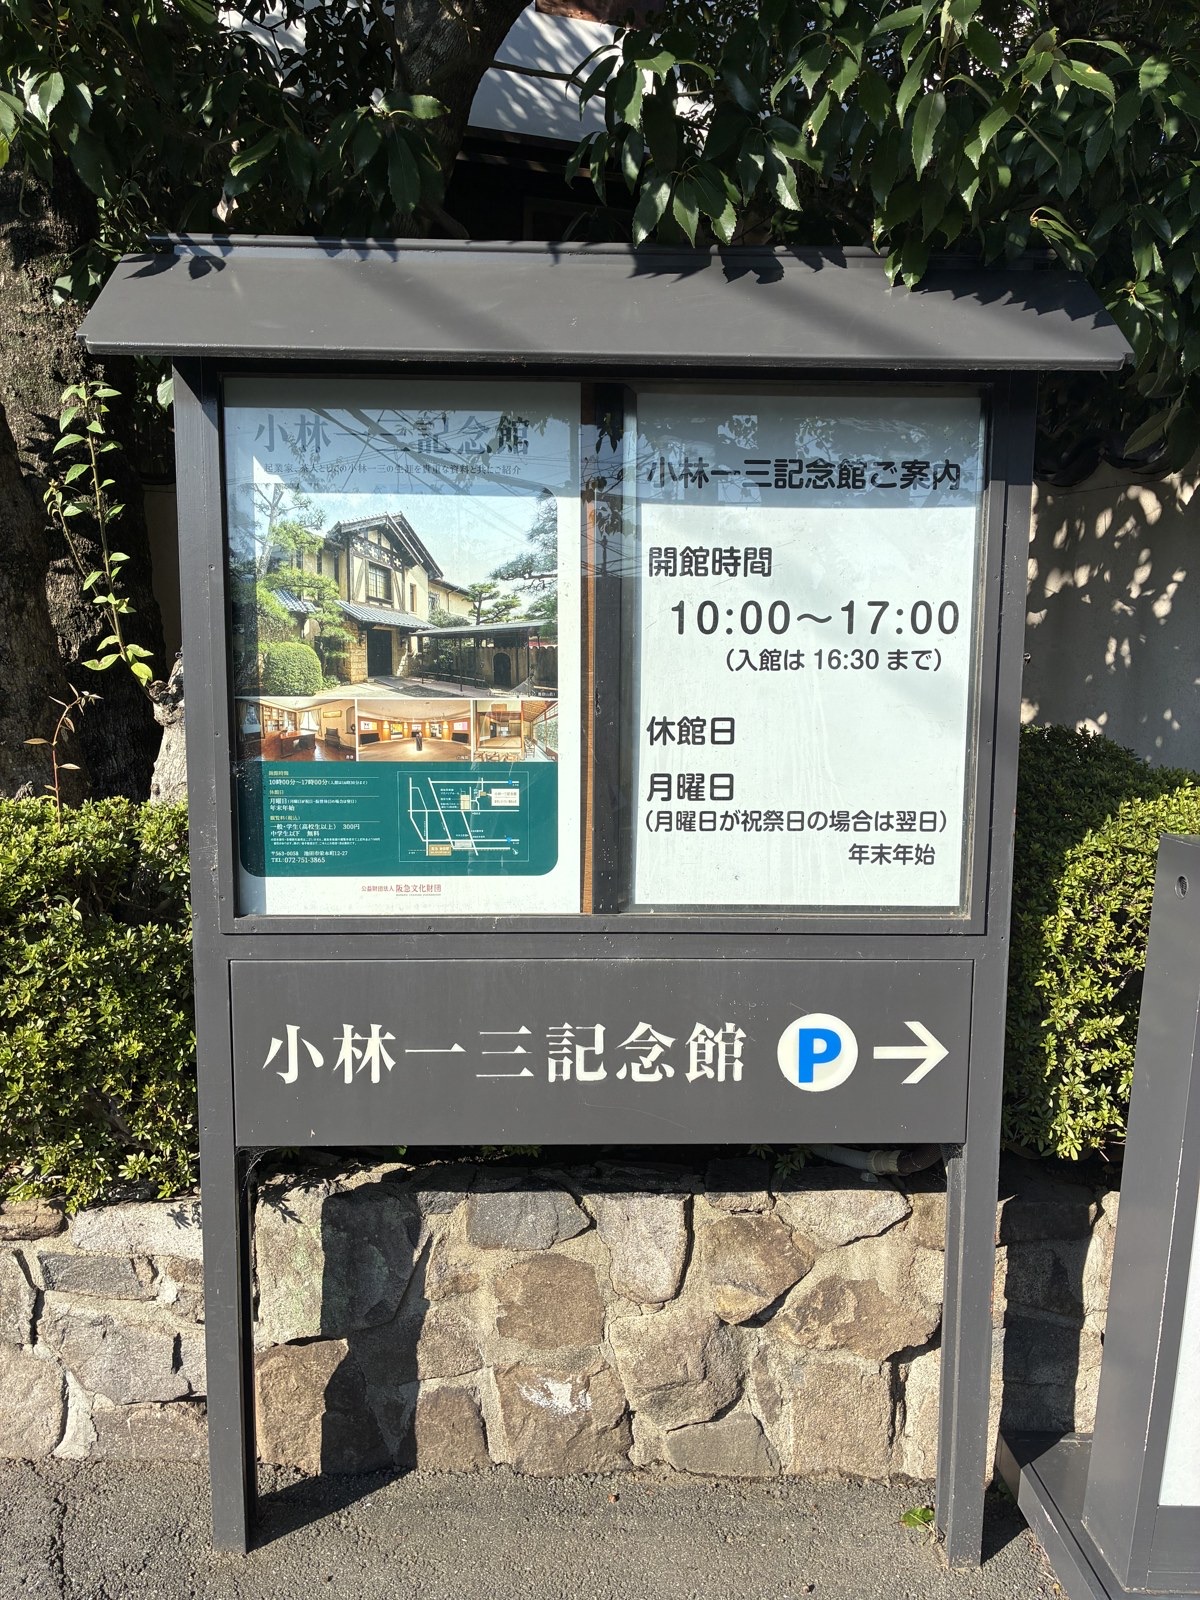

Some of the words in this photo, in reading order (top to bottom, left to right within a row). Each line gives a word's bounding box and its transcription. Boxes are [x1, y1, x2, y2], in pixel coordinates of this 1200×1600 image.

[254, 413, 530, 455] 小林一三記念館
[648, 457, 961, 490] 小林一三記念館ご案内
[649, 546, 773, 577] 開館時間
[646, 716, 736, 746] 休館日
[646, 772, 734, 802] 月曜日
[645, 810, 947, 833] (月曜日が祝祭日の場合は翌日)
[848, 843, 935, 866] 年末年始
[396, 884, 441, 893] 阪急文化財団
[262, 1021, 748, 1086] 小林一三記念館
[797, 1027, 842, 1084] P
